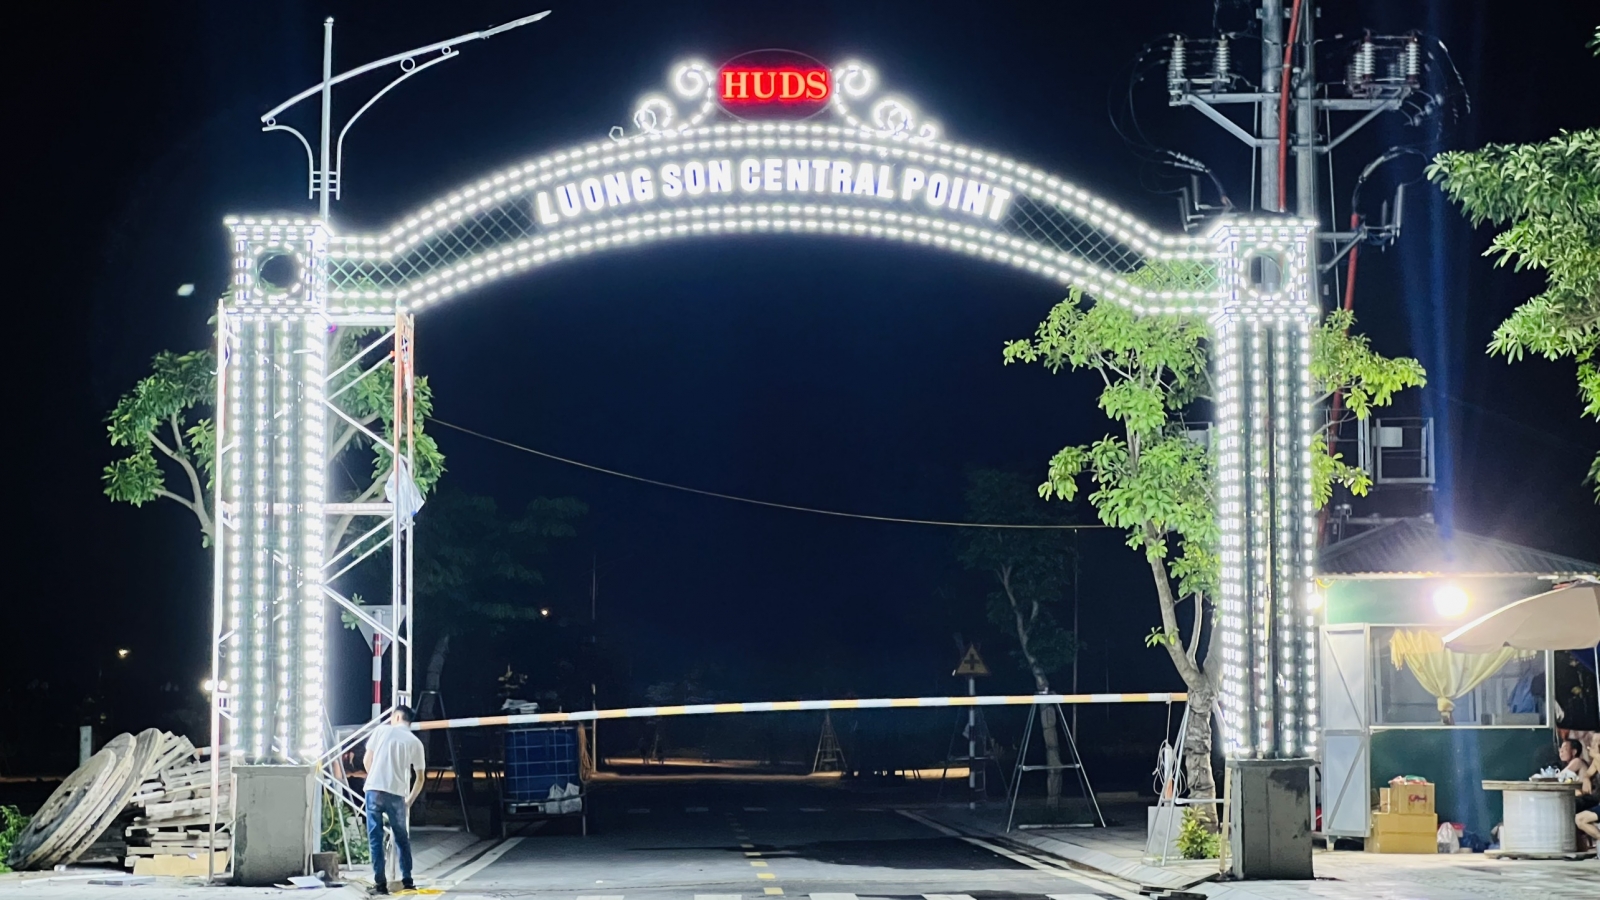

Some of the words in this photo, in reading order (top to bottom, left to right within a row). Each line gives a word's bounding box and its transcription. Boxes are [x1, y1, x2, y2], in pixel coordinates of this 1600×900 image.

[722, 71, 828, 99] HUDS
[537, 168, 654, 225] LUONG
[661, 159, 732, 197] SON
[740, 158, 894, 199] CENTRAL
[902, 168, 1011, 221] POINT
